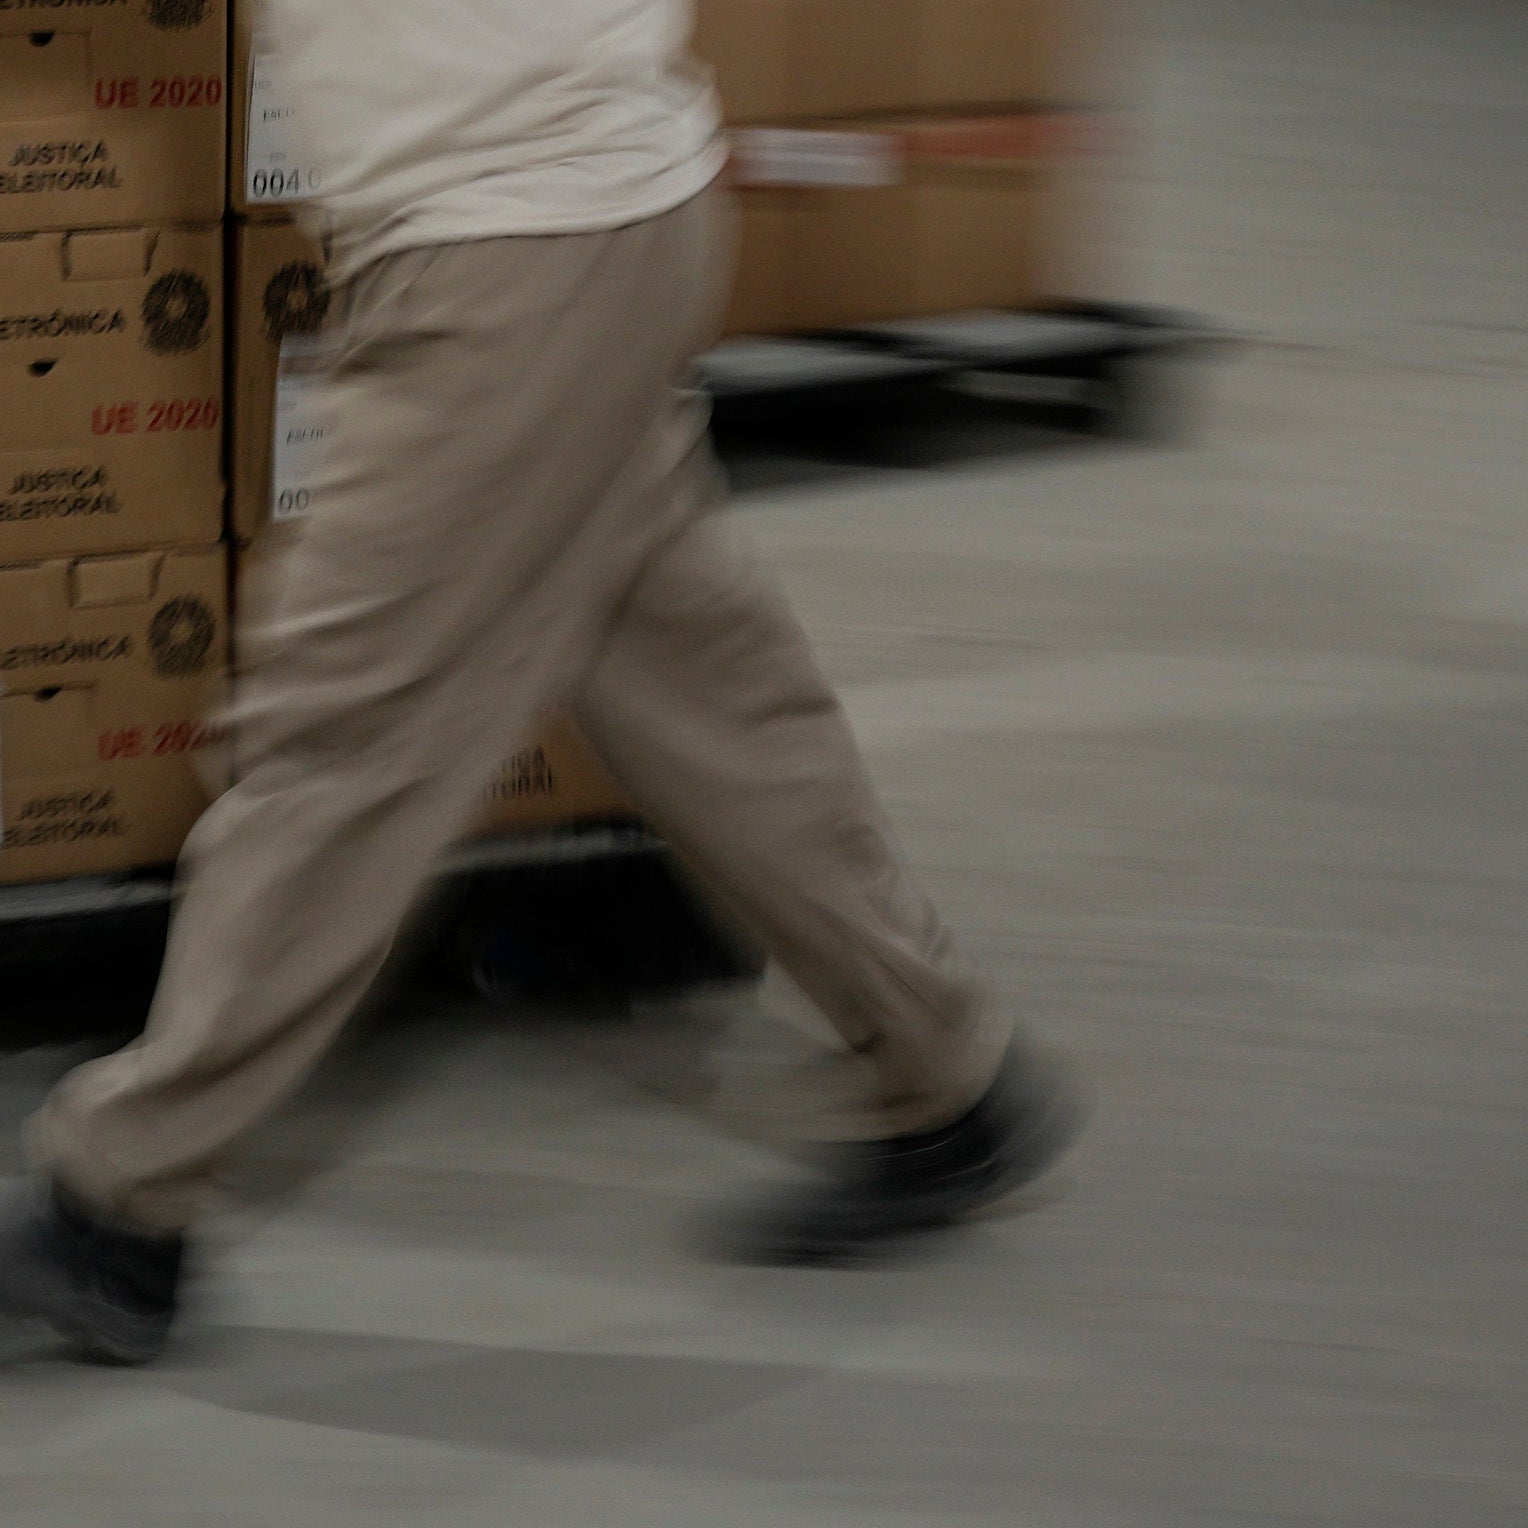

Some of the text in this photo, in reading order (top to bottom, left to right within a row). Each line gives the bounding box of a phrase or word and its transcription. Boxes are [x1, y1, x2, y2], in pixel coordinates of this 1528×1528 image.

[94, 76, 222, 110] UE 2020
[8, 139, 109, 171] JUSTIÇA
[90, 398, 219, 436] UE 2020
